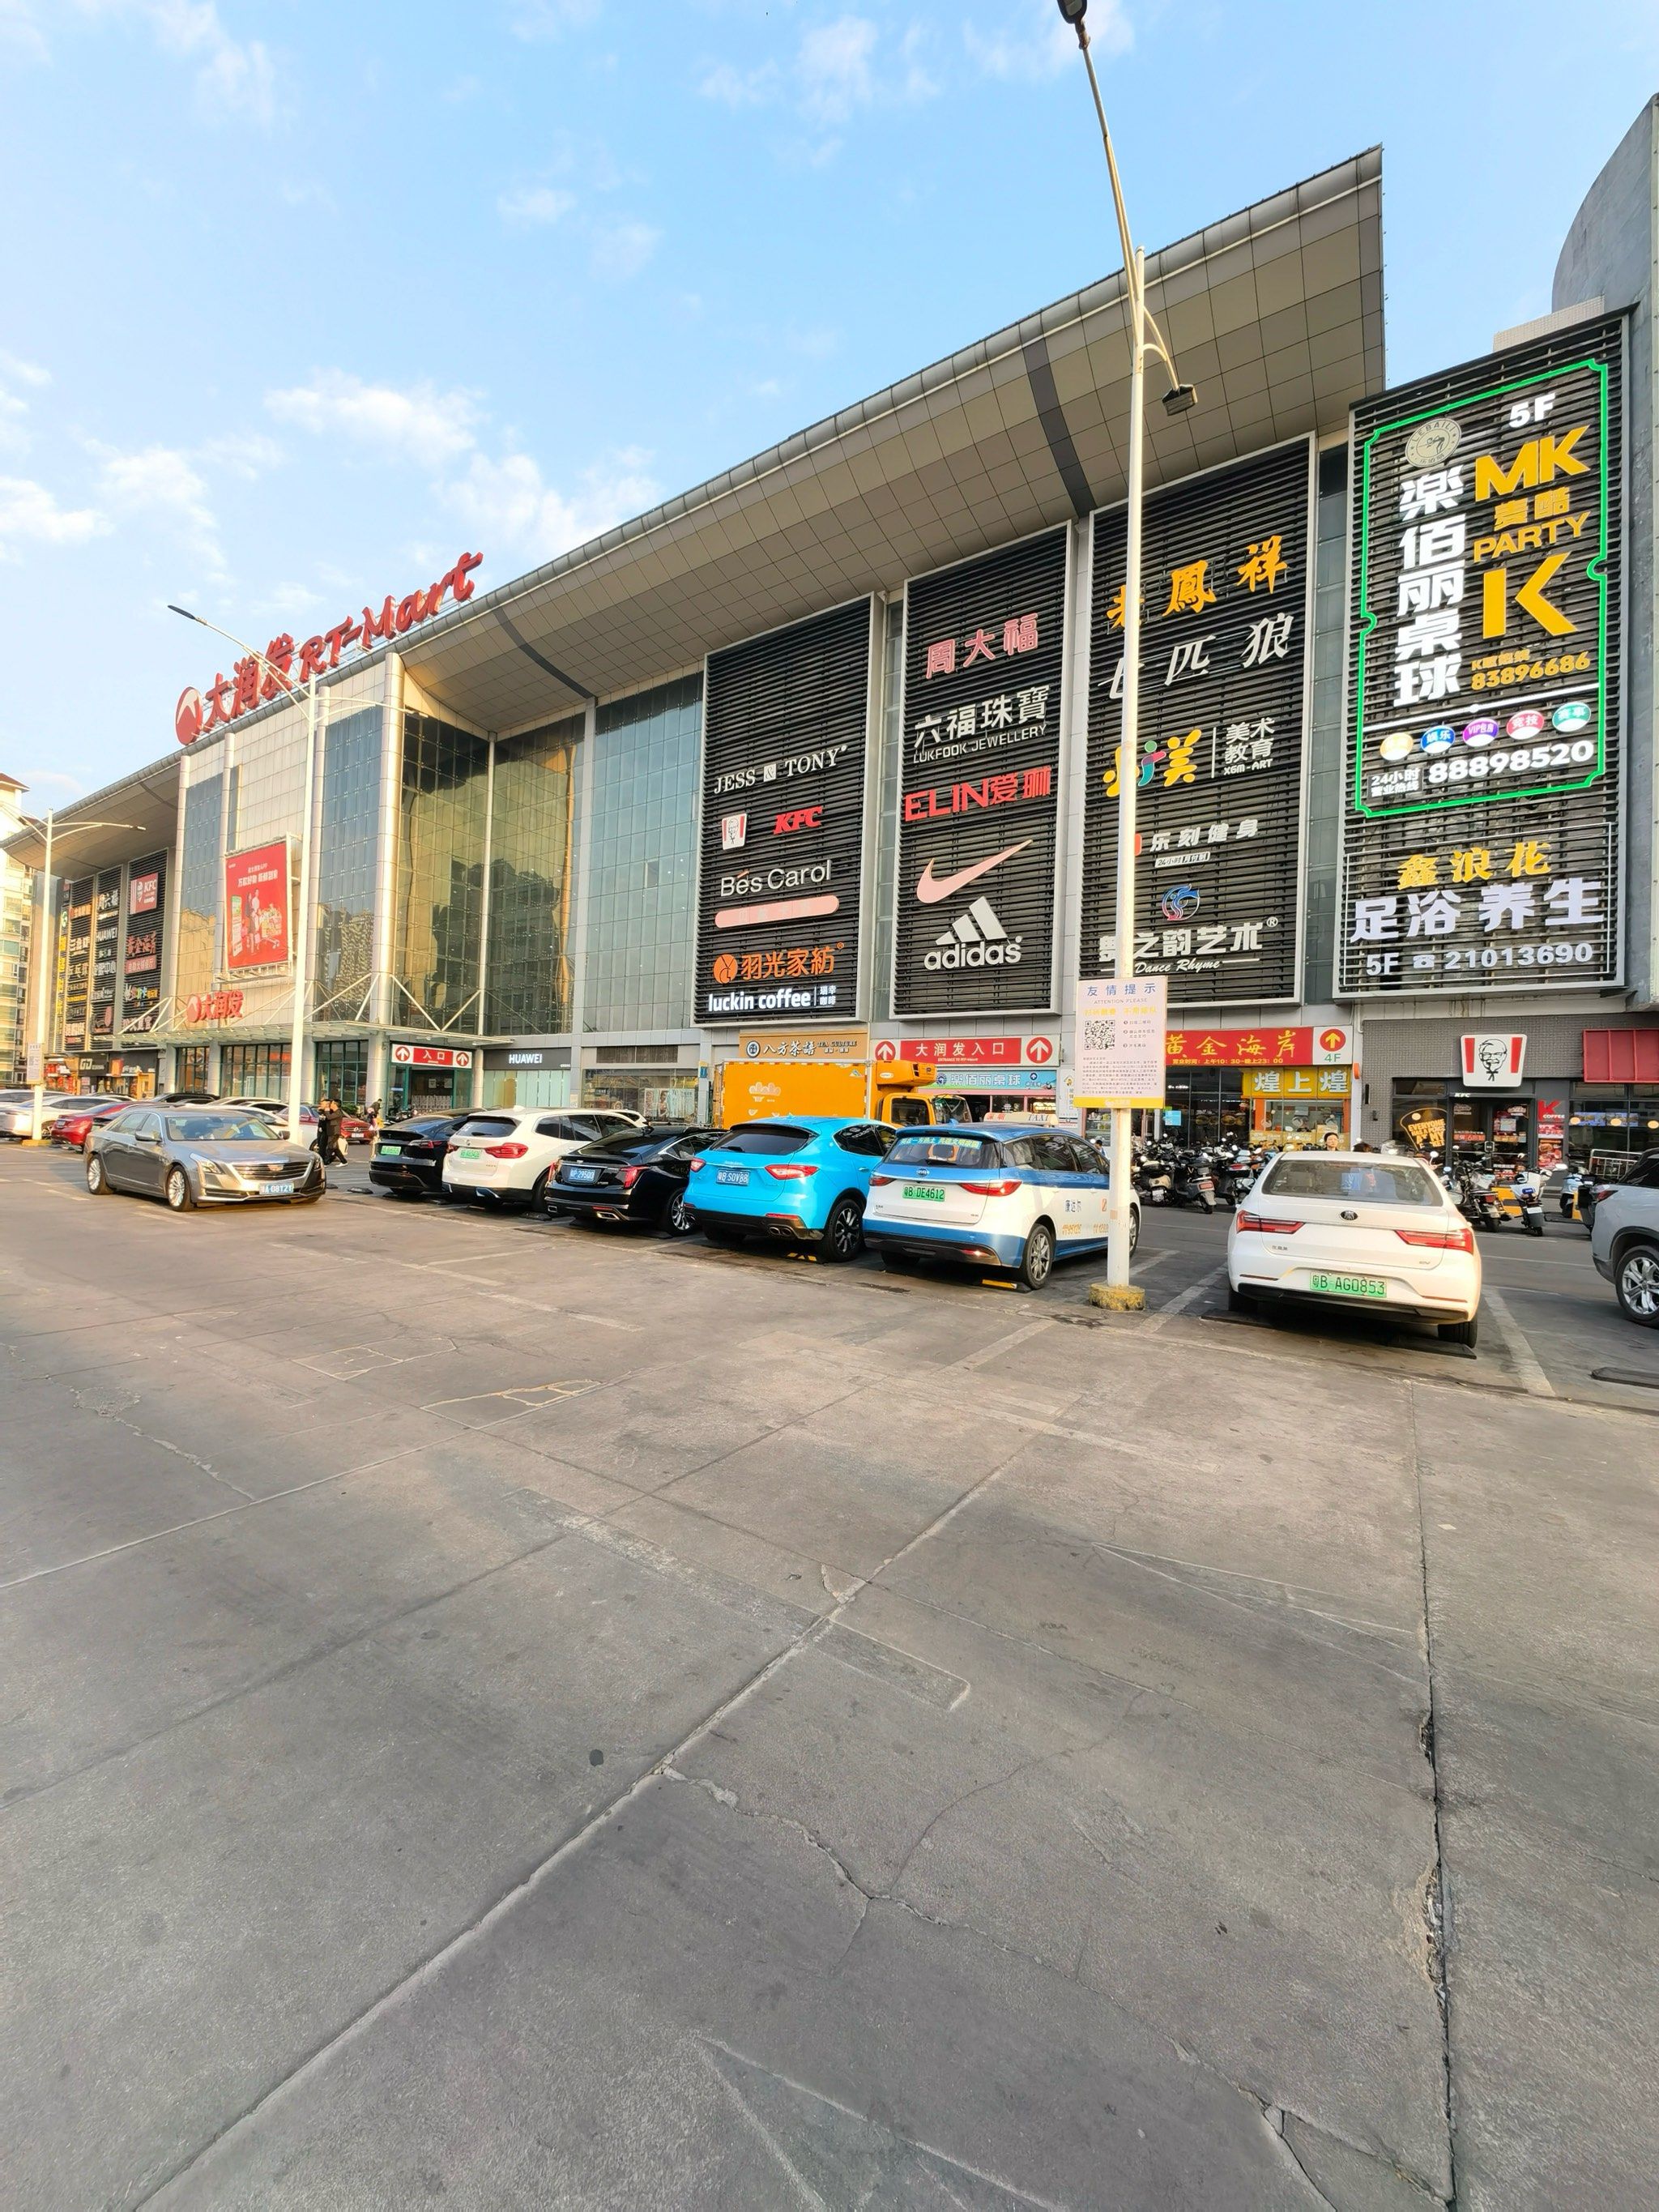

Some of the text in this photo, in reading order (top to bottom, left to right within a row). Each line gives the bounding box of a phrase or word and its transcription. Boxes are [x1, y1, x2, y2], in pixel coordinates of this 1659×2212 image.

[1509, 393, 1555, 428] 5F
[1475, 425, 1591, 502] MK
[1473, 511, 1591, 563] PARTY
[1482, 551, 1578, 639] K
[299, 551, 484, 683] RT-Mart
[926, 613, 1039, 679] 周大福
[203, 633, 295, 733] 大润发
[1471, 651, 1591, 690] 83896686
[914, 685, 1050, 749] 六福珠寶
[1226, 717, 1276, 745] 美术
[1512, 715, 1538, 728] 竞技
[913, 724, 1047, 763] LUKFOOK JEWELLERY
[1224, 737, 1274, 764] 教育
[1427, 729, 1451, 743] 娱乐
[714, 770, 756, 795] JESS
[784, 746, 843, 778] TONY
[1428, 741, 1594, 784] 88898520
[1371, 768, 1421, 787] 24小时
[773, 806, 823, 835] KFC
[1149, 818, 1259, 852] 乐刻健身
[720, 860, 832, 897] Bés Carol
[1397, 840, 1552, 890] 鑫浪花
[144, 880, 156, 892] KFC
[96, 928, 117, 942] HUAWEI
[923, 940, 1021, 971] adidas
[1135, 957, 1220, 974] Dance Rhyme
[1366, 942, 1593, 976] 5F 21013690
[708, 988, 812, 1012] luckin coffee
[819, 996, 836, 1006] 咖啡
[1087, 983, 1156, 996] 友情提示
[199, 991, 244, 1021] 大润发
[423, 1050, 445, 1061] 入口
[509, 1053, 543, 1064] HUAWEI
[915, 1041, 1004, 1057] 大润发入口
[1166, 1030, 1296, 1058] 黄金海岸
[1324, 1053, 1341, 1063] 4F
[1253, 1069, 1349, 1094] 煌上煌
[1408, 1118, 1445, 1132] EVERYONE
